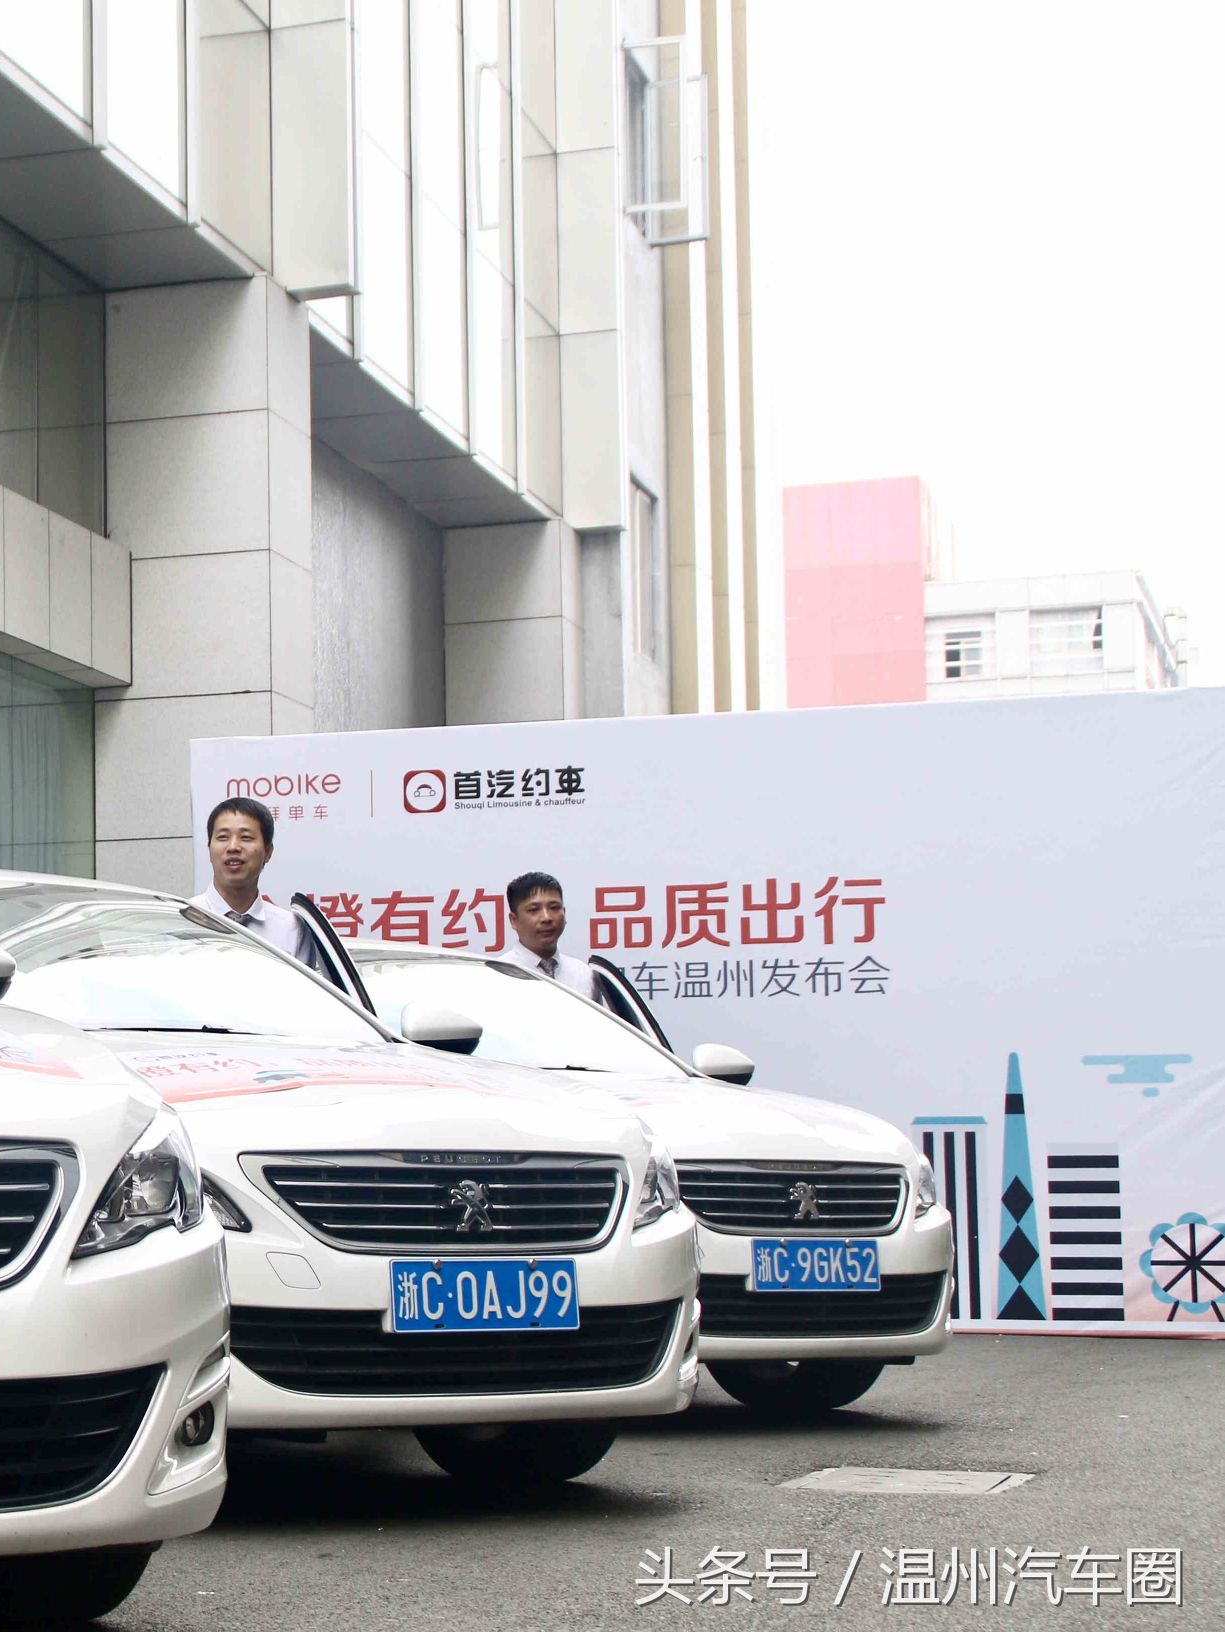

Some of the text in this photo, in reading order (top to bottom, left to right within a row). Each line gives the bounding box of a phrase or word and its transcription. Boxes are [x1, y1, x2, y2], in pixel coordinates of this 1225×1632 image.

[226, 773, 342, 799] mobike
[454, 801, 485, 810] Shouqi
[487, 799, 532, 809] Limousine
[544, 798, 586, 806] chauffeur
[589, 876, 886, 949] 品质出行
[757, 1247, 877, 1283] 浙C·9GK52
[397, 1268, 573, 1321] 浙C·0AJ99
